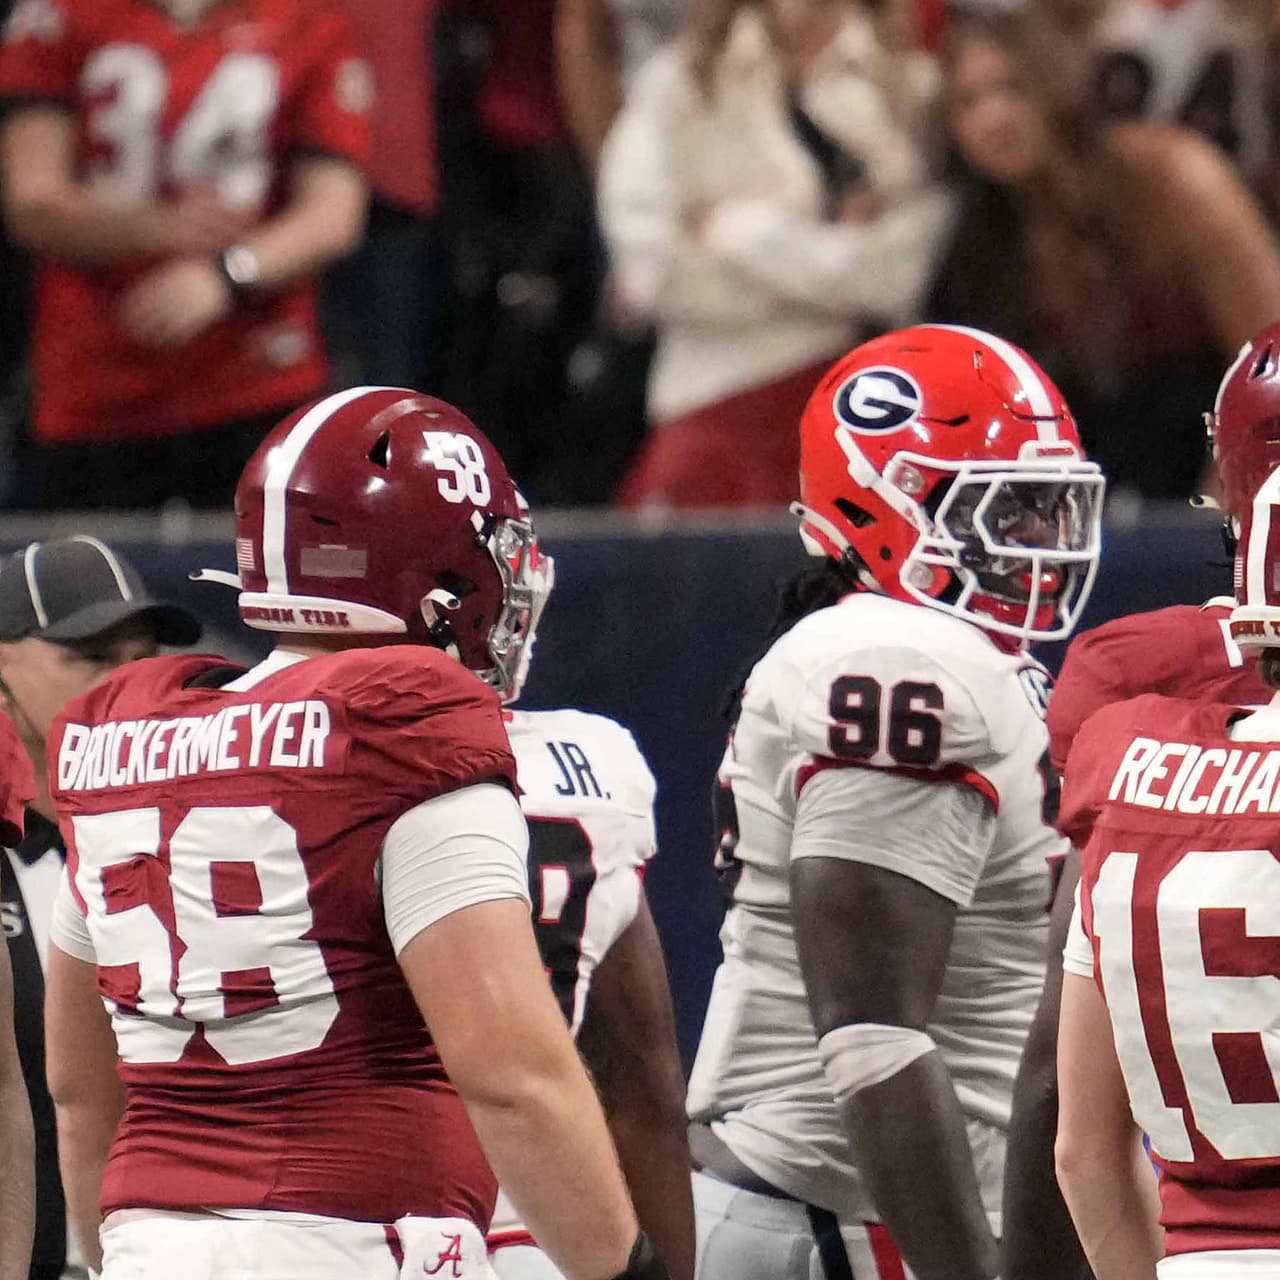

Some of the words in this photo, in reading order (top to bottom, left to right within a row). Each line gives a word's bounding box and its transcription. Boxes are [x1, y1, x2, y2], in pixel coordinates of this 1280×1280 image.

[80, 42, 281, 212] 34
[423, 431, 491, 508] 58
[58, 700, 330, 791] BROCKERMEYER
[829, 675, 944, 765] 96
[546, 742, 611, 801] JR.
[74, 806, 341, 1066] 58
[424, 1231, 466, 1280] A
